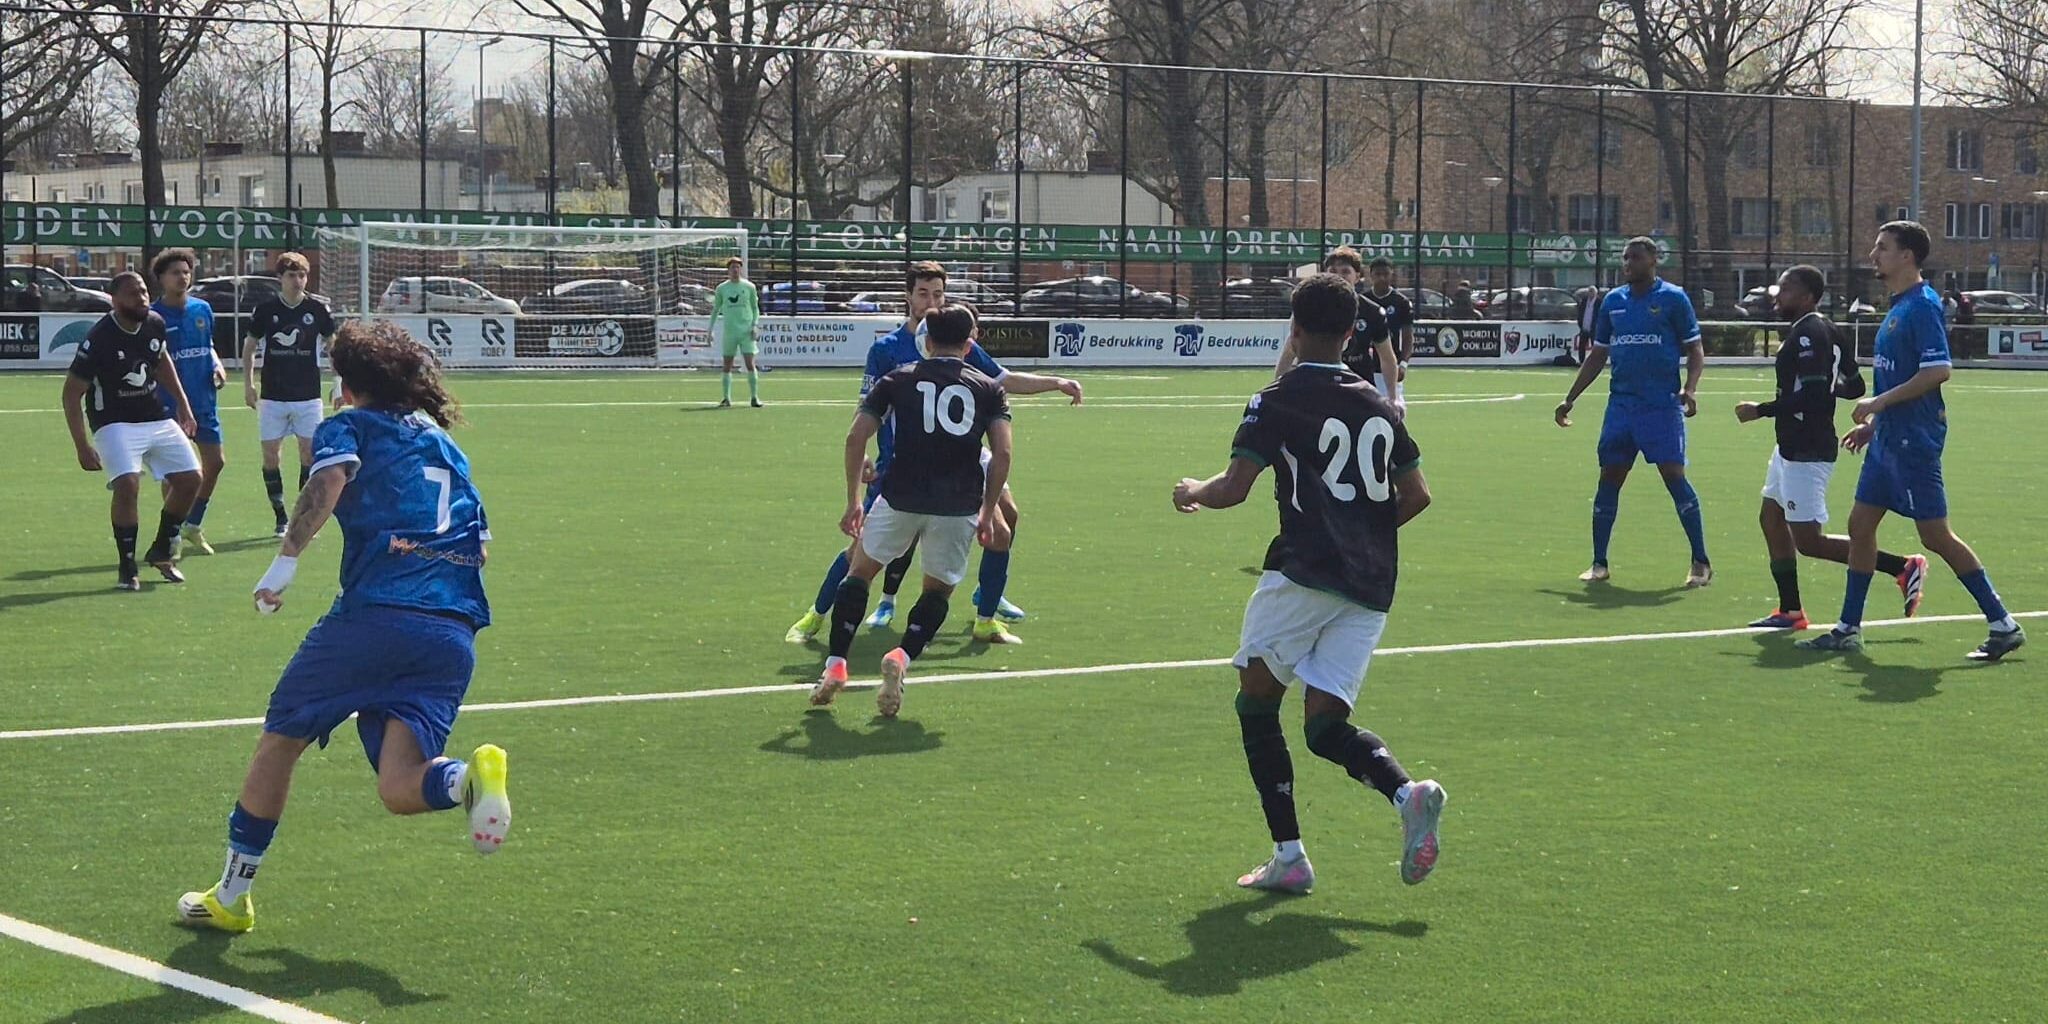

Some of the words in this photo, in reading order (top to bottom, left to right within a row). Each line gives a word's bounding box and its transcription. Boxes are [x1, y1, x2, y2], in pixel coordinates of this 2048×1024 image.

[3, 206, 121, 241] JDEN
[149, 209, 370, 244] VOORAAN
[932, 226, 1056, 252] ZINGEN
[1096, 230, 1181, 255] NAAR
[1199, 231, 1306, 256] VOREN
[1325, 233, 1475, 257] SPARTAAN
[552, 325, 568, 335] DE
[571, 325, 604, 335] VAAN
[796, 323, 855, 332] VERVANGING
[977, 327, 1033, 340] OGISTICS
[1462, 329, 1491, 338] WORDT
[1493, 329, 1499, 338] U
[1053, 335, 1086, 354] PW
[1089, 335, 1164, 350] Bedrukking
[1172, 335, 1205, 354] PW
[1207, 335, 1279, 350] Bedrukking
[1462, 341, 1480, 350] OOK
[1522, 334, 1572, 353] Jupiler
[916, 381, 976, 436] 10
[1318, 416, 1394, 502] 20
[422, 466, 451, 534] 7
